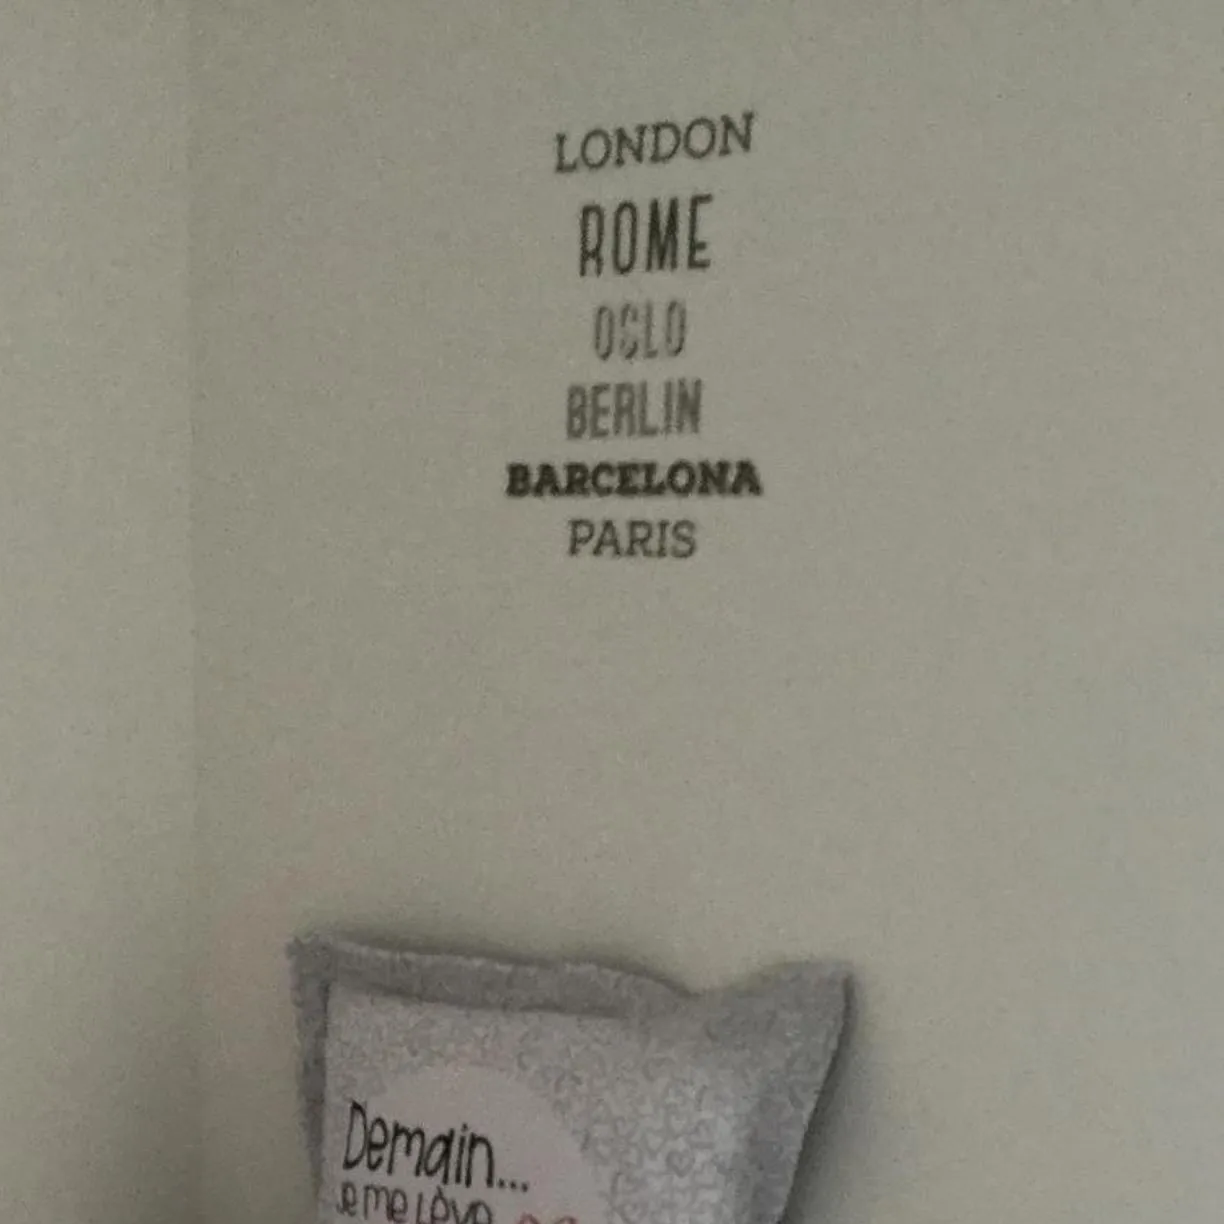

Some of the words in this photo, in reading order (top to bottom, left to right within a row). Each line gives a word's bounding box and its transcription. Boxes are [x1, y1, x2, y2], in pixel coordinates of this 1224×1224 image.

[553, 110, 756, 175] LONDON
[578, 193, 714, 278] ROME
[565, 377, 703, 441] BERLIN
[504, 458, 765, 499] BARCELONA
[566, 517, 699, 560] PARIS
